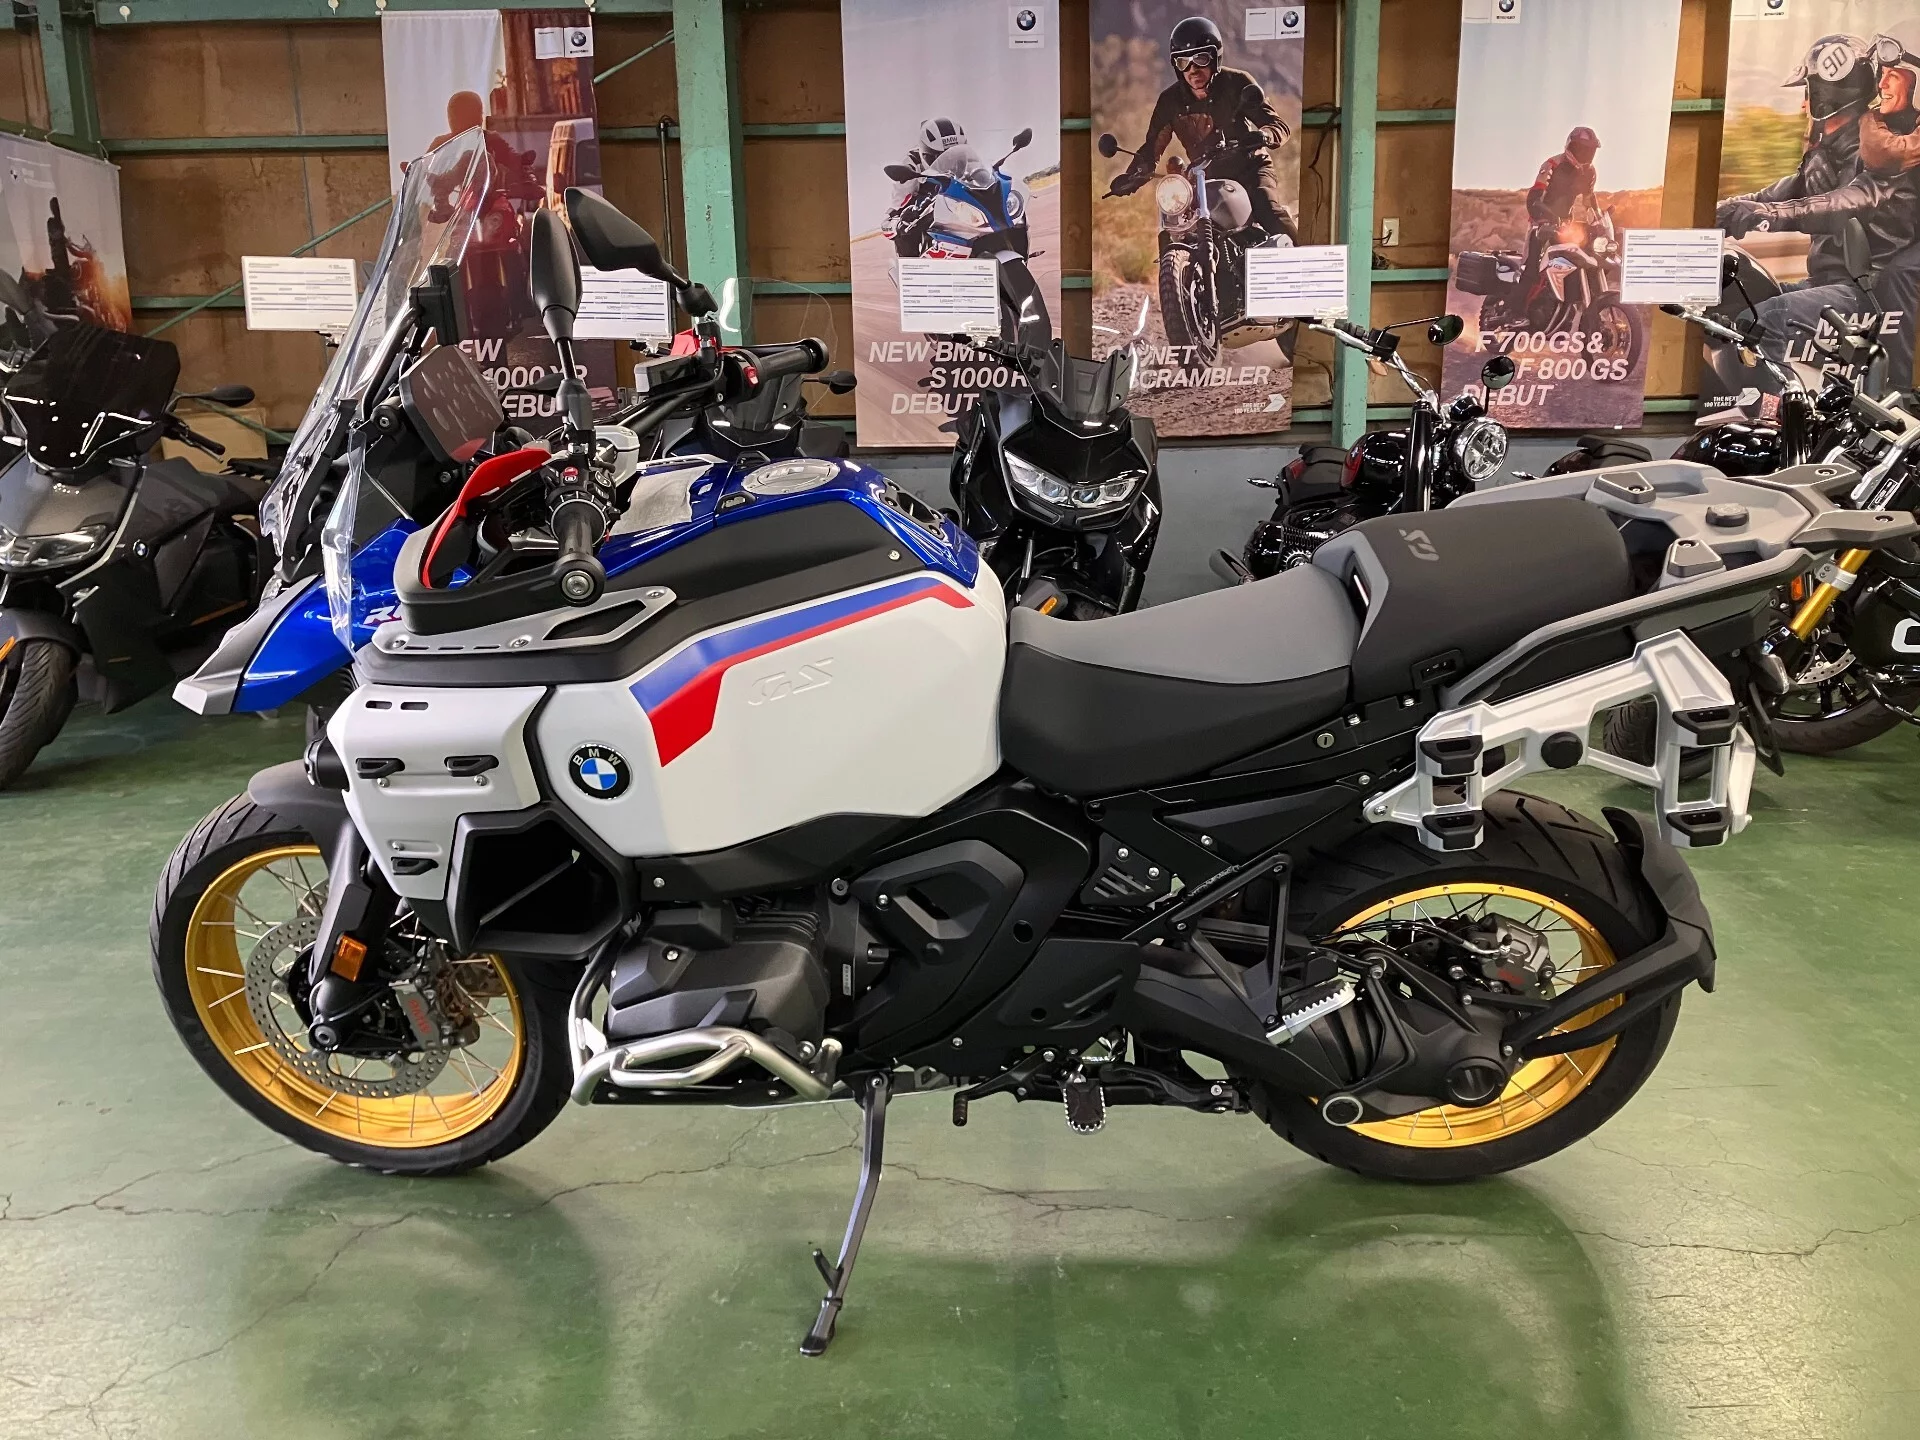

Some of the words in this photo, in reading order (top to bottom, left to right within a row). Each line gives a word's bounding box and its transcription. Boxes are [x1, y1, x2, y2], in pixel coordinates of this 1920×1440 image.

[458, 338, 504, 362] EW
[869, 341, 931, 362] NEW
[1475, 331, 1492, 353] F
[1499, 331, 1546, 353] 700
[1549, 331, 1586, 354] GS
[1587, 332, 1604, 354] &
[930, 367, 947, 388] S
[951, 366, 1009, 388] 1000
[1517, 358, 1536, 379] F
[1538, 358, 1587, 380] 800
[1591, 358, 1630, 381] GS
[891, 393, 980, 415] DEBUT
[748, 657, 834, 706] GS
[573, 748, 621, 767] BMW
